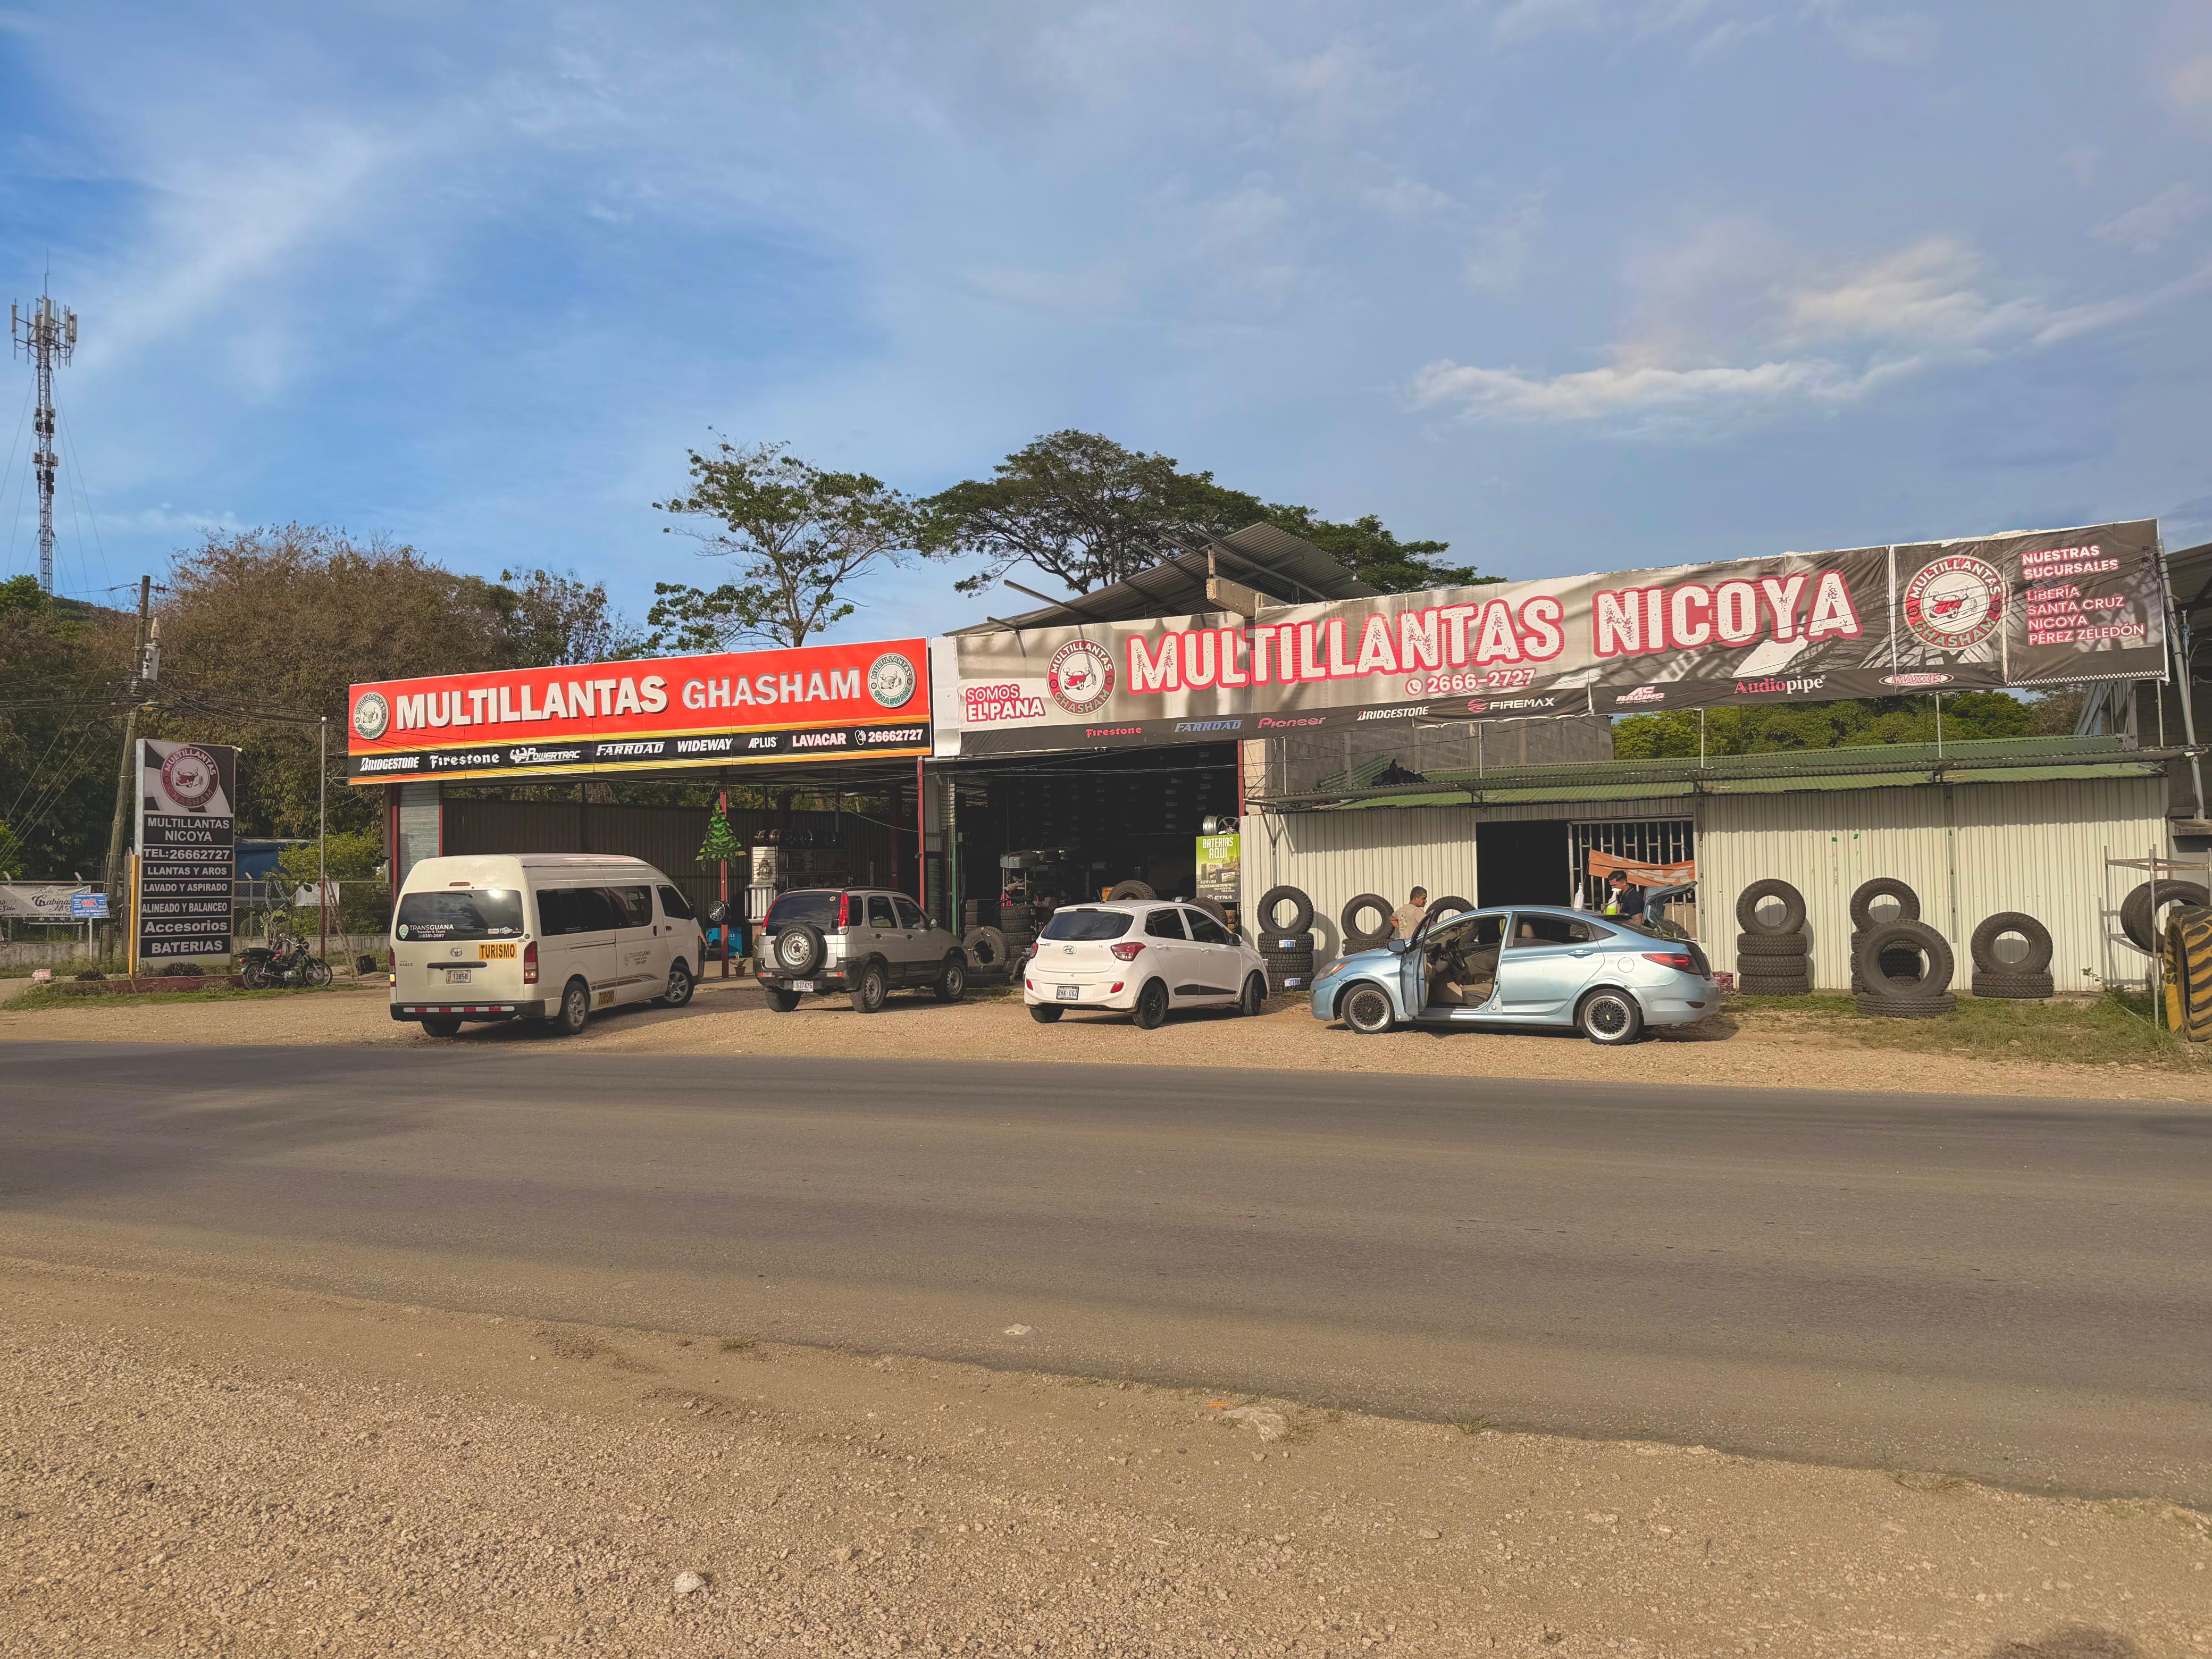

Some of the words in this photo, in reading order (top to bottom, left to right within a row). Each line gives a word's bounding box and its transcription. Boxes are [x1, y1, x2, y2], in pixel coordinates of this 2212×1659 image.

[2022, 545, 2100, 564] NUESTRAS
[2023, 559, 2119, 579] SUCURSALES
[1909, 559, 2001, 599] MULTILLANTAS
[2027, 584, 2080, 601] LIBERÍA
[2027, 601, 2079, 615] SANTA
[2082, 597, 2124, 610] CRUZ
[2028, 615, 2088, 631] NICOYA
[1129, 597, 1562, 692] MULTILLANTAS
[1596, 571, 1859, 655] NICOYA
[2029, 630, 2073, 644] PÉREZ
[2077, 623, 2145, 640] ZELEDÓN
[1050, 641, 1112, 674] MULTILLANTAS
[870, 656, 912, 680] MULTILLANTAS
[1427, 668, 1536, 693] 2666-2727
[1891, 674, 1941, 684] MAXXIS
[396, 675, 668, 730] MULTILLANTAS
[683, 666, 861, 709] GHASHAM
[967, 685, 1019, 702] SOMOS
[1615, 692, 1666, 702] RACING
[967, 703, 987, 720] EL
[990, 699, 1045, 718] PANA
[1489, 698, 1555, 710] FIREMAX
[1356, 706, 1429, 721] BRIDGESTONE
[1174, 719, 1243, 733] FARROAD
[1258, 716, 1326, 729] Pioneer
[1085, 726, 1142, 738] Firestone
[359, 756, 420, 772] BRIDGESTONE
[429, 753, 500, 769] Firestone
[596, 741, 665, 756] FARROAD
[677, 738, 733, 753] WIDEWAY
[748, 736, 777, 749] APLUS
[792, 733, 847, 747] LAVACAR
[868, 729, 924, 743] 26662727
[164, 749, 216, 776] MULTILLANTAS
[147, 817, 230, 830] MULTILLANTAS
[165, 830, 213, 842] NICOYA
[147, 866, 190, 876] LLANTAS
[194, 867, 199, 875] Y
[144, 883, 177, 892] LAVADO
[180, 883, 185, 892] Y
[187, 883, 228, 892] ASPIRADO
[141, 903, 180, 914] ALINEADO
[182, 903, 187, 912] Y
[189, 902, 227, 912] BALANCEO
[144, 920, 228, 933] Accesorios
[152, 940, 223, 954] BATERIAS
[480, 943, 516, 959] TURISMO
